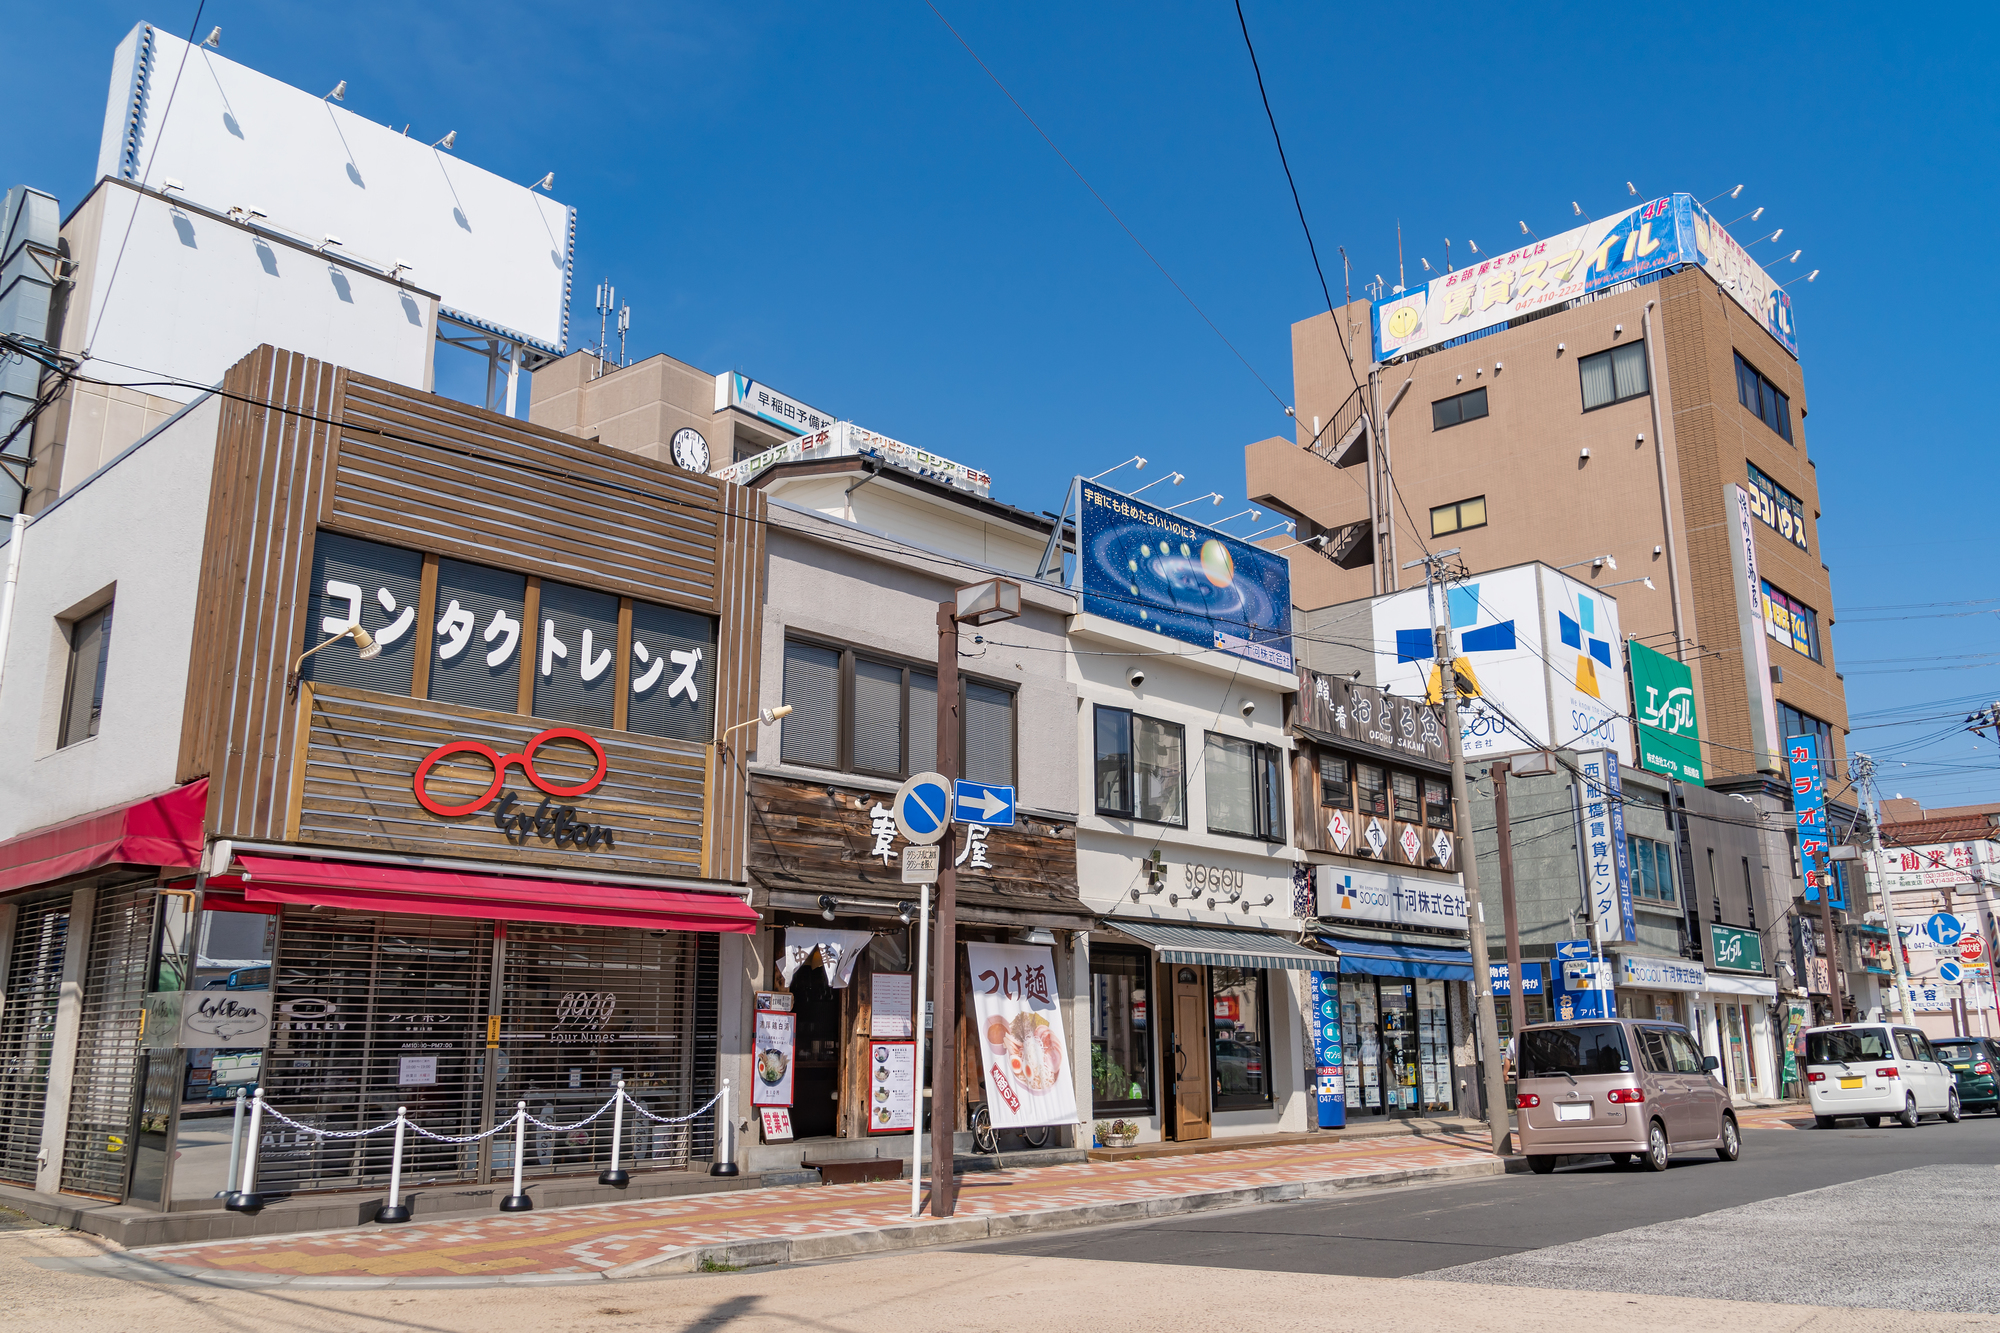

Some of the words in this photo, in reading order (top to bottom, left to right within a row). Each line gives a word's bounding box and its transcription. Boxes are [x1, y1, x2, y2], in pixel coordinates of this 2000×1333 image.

[1643, 198, 1669, 219] 4F
[1440, 222, 1660, 324] 賃貸スマイル
[1446, 242, 1547, 287] お部屋さがしは
[1383, 293, 1422, 316] SMILE
[1515, 281, 1584, 312] 047-410-2222
[1384, 328, 1426, 350] GROUP
[801, 429, 830, 452] 日本
[750, 445, 788, 472] ロシア
[917, 451, 956, 470] ロシア
[966, 469, 991, 485] 日本
[1084, 488, 1198, 541] 宇宙にも住めたらいいのにネ
[1748, 481, 1807, 547] ココハウス
[322, 579, 703, 702] コンタクトレンズ
[1351, 689, 1442, 748] おどる魚
[1640, 686, 1693, 735] エイブル
[1572, 709, 1615, 743] SOGOU
[1369, 730, 1394, 744] ODORU
[1397, 738, 1425, 753] SAKANA
[1584, 762, 1610, 933] 西船橋賃貸センター
[1953, 846, 1973, 857] 株式
[1186, 861, 1244, 889] SOGOU
[1359, 891, 1389, 907] SOGOU
[1392, 886, 1466, 917] 十河株式会社
[1717, 934, 1742, 962] エイブル
[978, 964, 1050, 1004] つけ麺
[1635, 967, 1660, 983] SOGOU
[1662, 965, 1703, 985] 十河株式会社
[1311, 976, 1323, 1063] お気軽にご相談下さい
[550, 1032, 577, 1044] Four
[580, 1032, 616, 1044] Nines
[763, 1111, 789, 1135] 営業中
